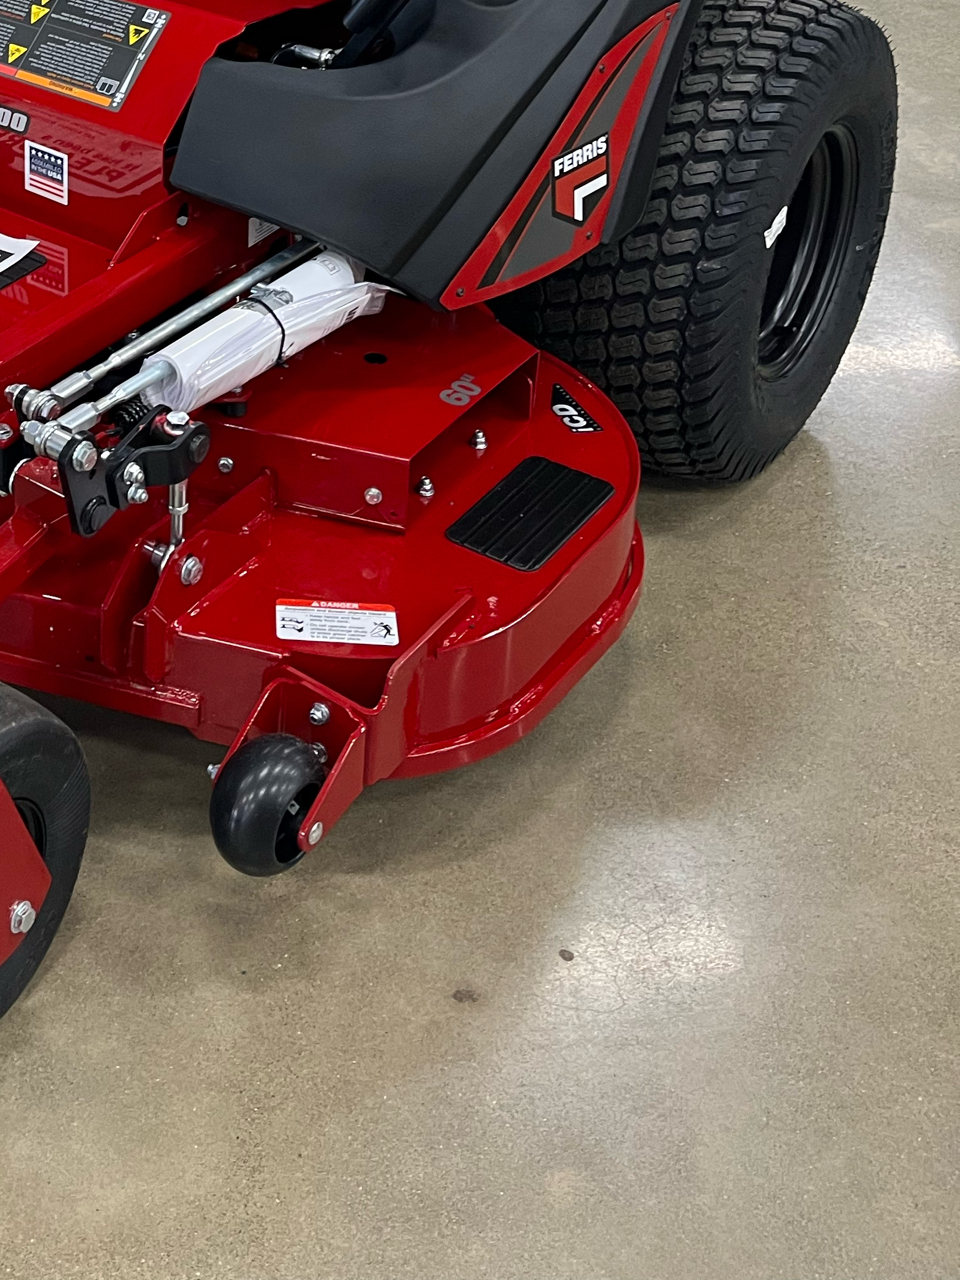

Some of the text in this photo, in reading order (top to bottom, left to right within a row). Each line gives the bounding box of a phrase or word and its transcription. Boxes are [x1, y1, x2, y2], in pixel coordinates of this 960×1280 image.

[48, 81, 74, 93] WARNING
[554, 136, 607, 177] FERRIS
[31, 158, 62, 174] ASSEMBLED
[47, 170, 62, 181] USA
[320, 601, 359, 609] DANGER
